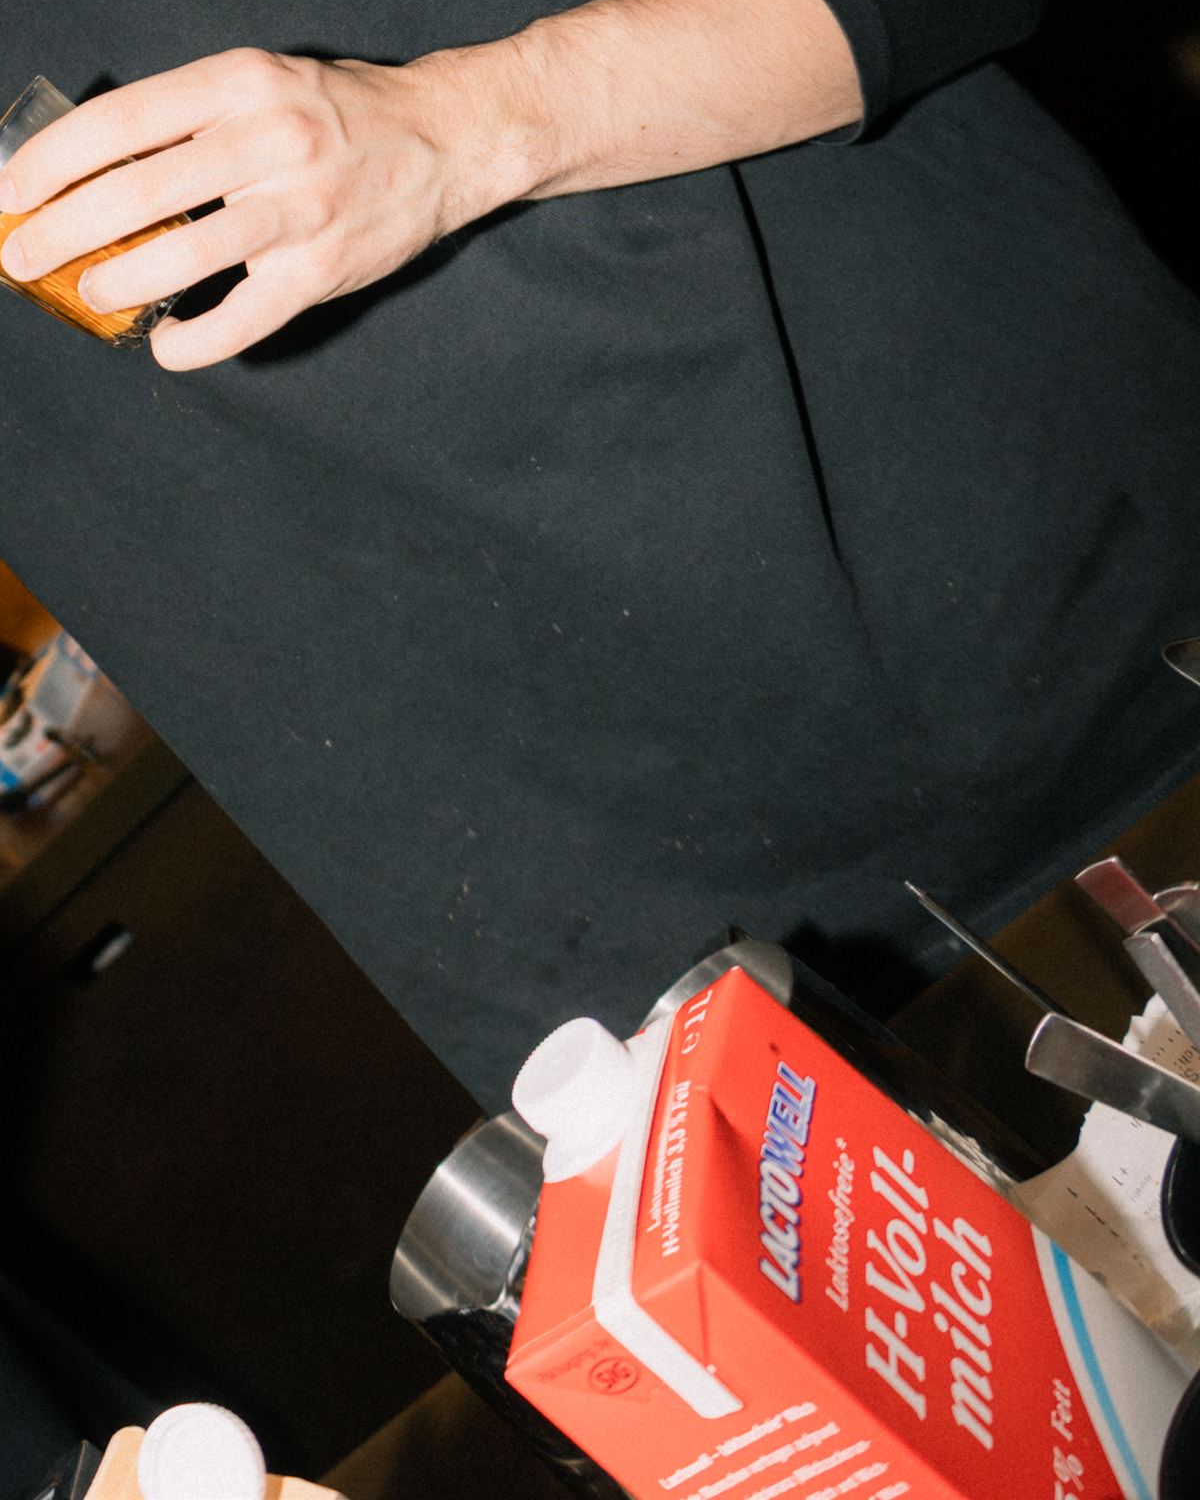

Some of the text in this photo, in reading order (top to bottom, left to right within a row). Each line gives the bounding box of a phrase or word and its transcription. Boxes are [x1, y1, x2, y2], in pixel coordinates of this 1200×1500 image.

[662, 1157, 684, 1257] H-Vollmilch
[758, 1061, 817, 1305] LACTOWELL
[865, 1145, 929, 1421] H-Voll-
[930, 1216, 993, 1451] milch
[1050, 1378, 1072, 1442] Fett
